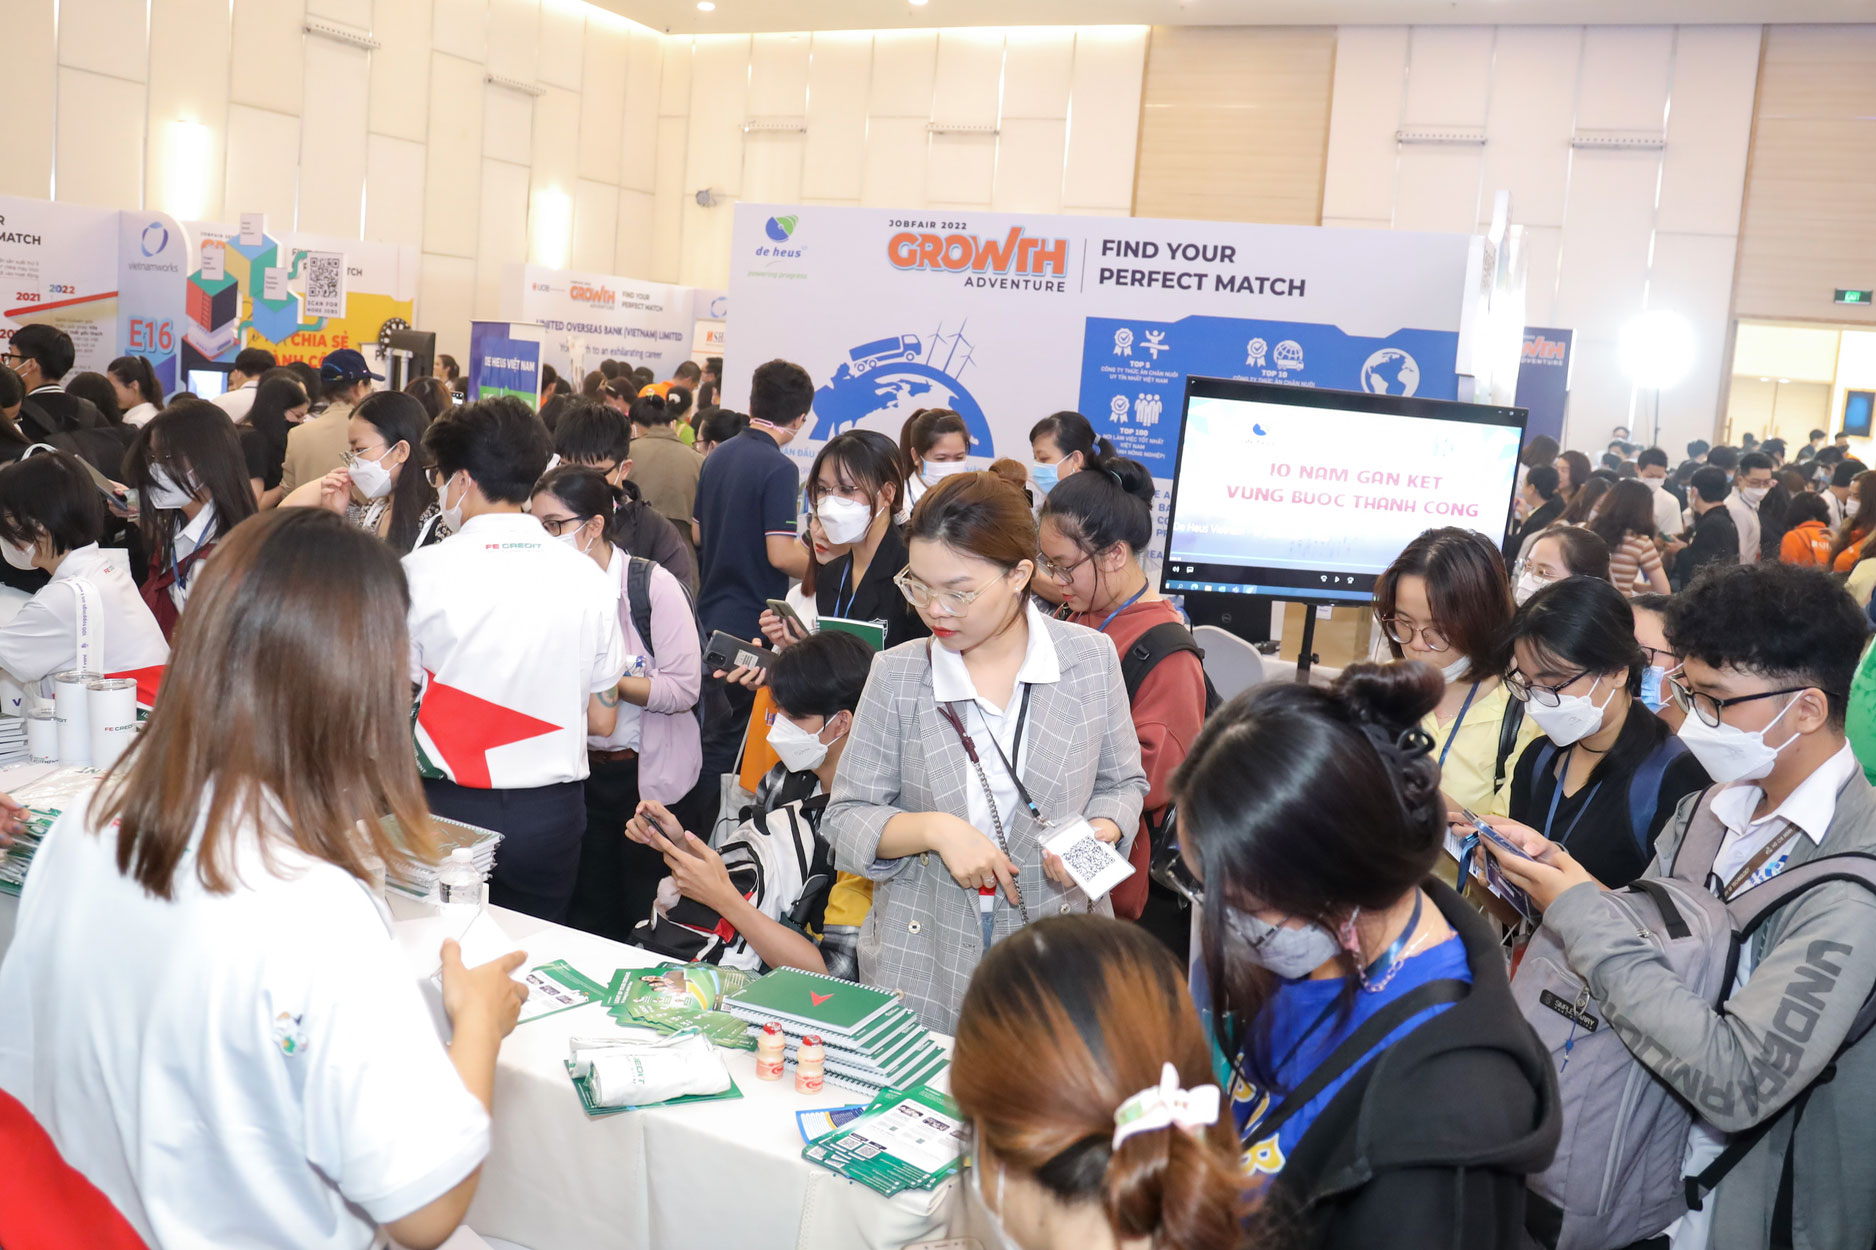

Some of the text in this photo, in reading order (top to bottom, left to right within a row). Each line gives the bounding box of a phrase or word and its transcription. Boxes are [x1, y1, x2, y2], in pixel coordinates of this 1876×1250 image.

[888, 219, 967, 230] JOBFAIR 2022
[755, 246, 802, 258] de heus
[887, 226, 1068, 276] GROWTH
[1101, 239, 1236, 263] FIND YOUR
[128, 262, 179, 273] vietnamworks
[347, 267, 363, 276] TCH
[49, 284, 75, 294] 2022
[964, 276, 1066, 293] ADVENTURE
[1099, 267, 1306, 297] PERFECT MATCH
[16, 292, 41, 302] 2021
[570, 285, 616, 305] GROWTH
[622, 290, 650, 301] FIND YOUR
[622, 301, 663, 312] PERFECT MATCH
[128, 318, 173, 350] E16
[566, 322, 603, 334] OVERSEAS
[604, 325, 623, 336] BANK
[658, 332, 683, 342] LIMITED
[291, 333, 327, 348] CHIA
[1521, 335, 1566, 358] WTH
[1129, 360, 1144, 368] TOP
[1261, 369, 1277, 377] TOP
[1135, 429, 1149, 437] 100
[1299, 465, 1349, 482] NAM
[1357, 470, 1400, 486] GAN
[1407, 474, 1443, 490] KET
[1226, 485, 1479, 517] VUNG BUOC THANH CONG
[1751, 939, 1853, 1104] UNDER
